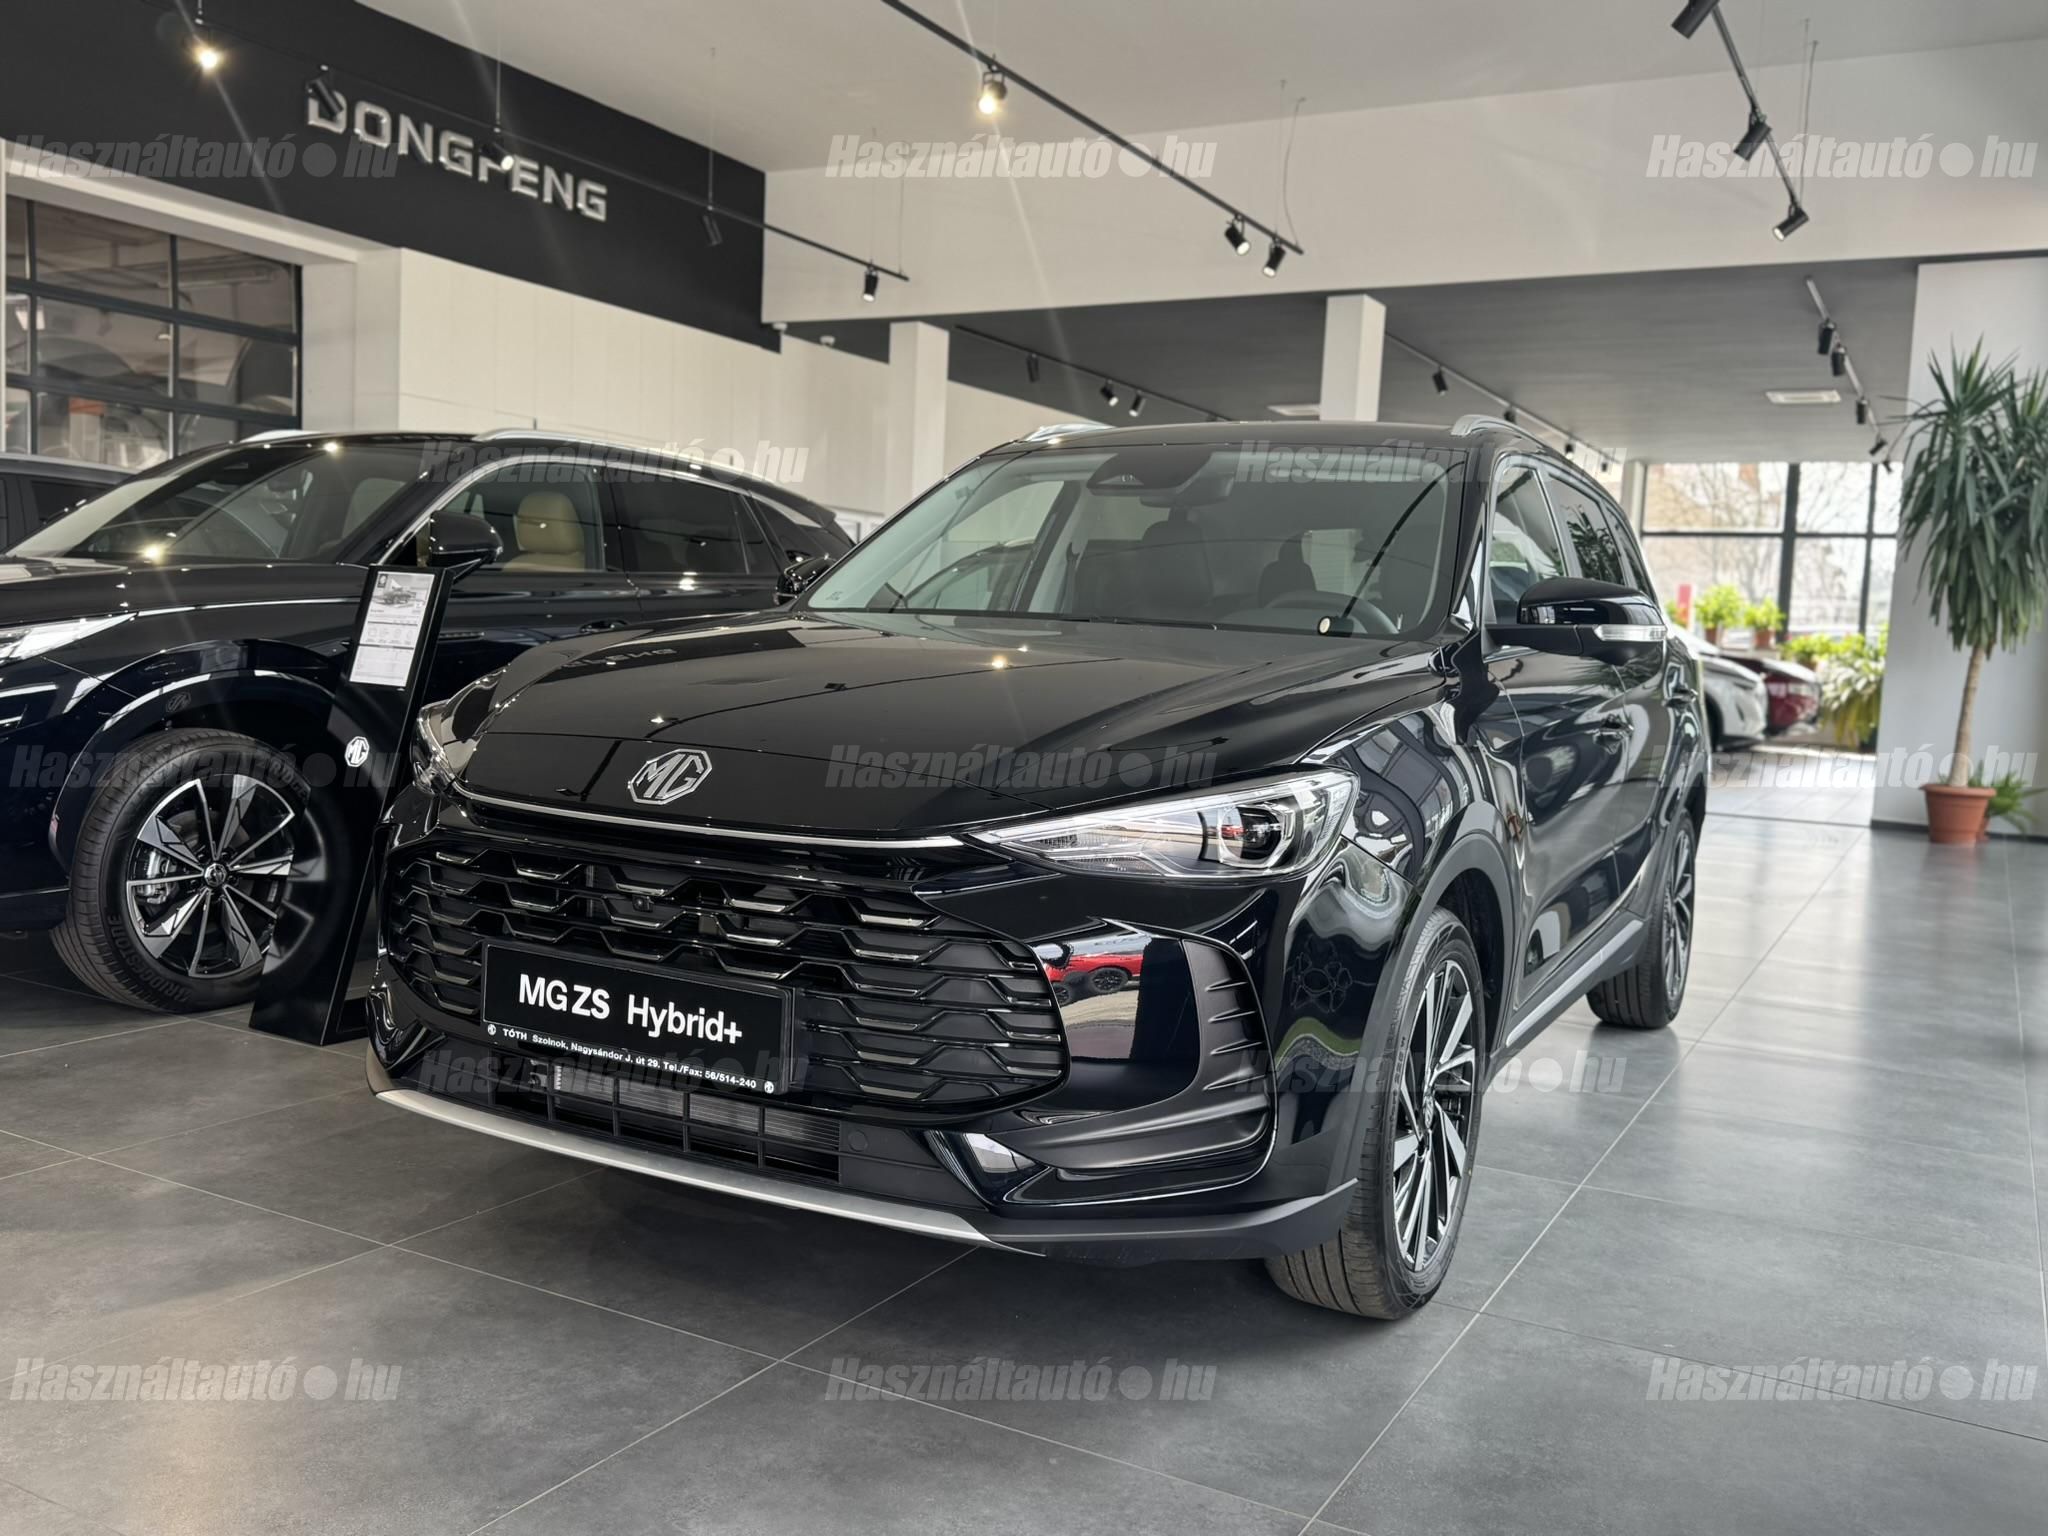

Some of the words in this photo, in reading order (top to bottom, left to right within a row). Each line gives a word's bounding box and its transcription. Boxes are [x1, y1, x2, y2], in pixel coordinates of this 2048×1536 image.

[345, 737, 370, 766] MG
[631, 750, 709, 802] MG
[627, 994, 743, 1045] Hybrid+
[503, 1028, 528, 1041] TÓTH
[532, 1034, 569, 1051] Szolnok,
[571, 1042, 624, 1062] Nagysándor
